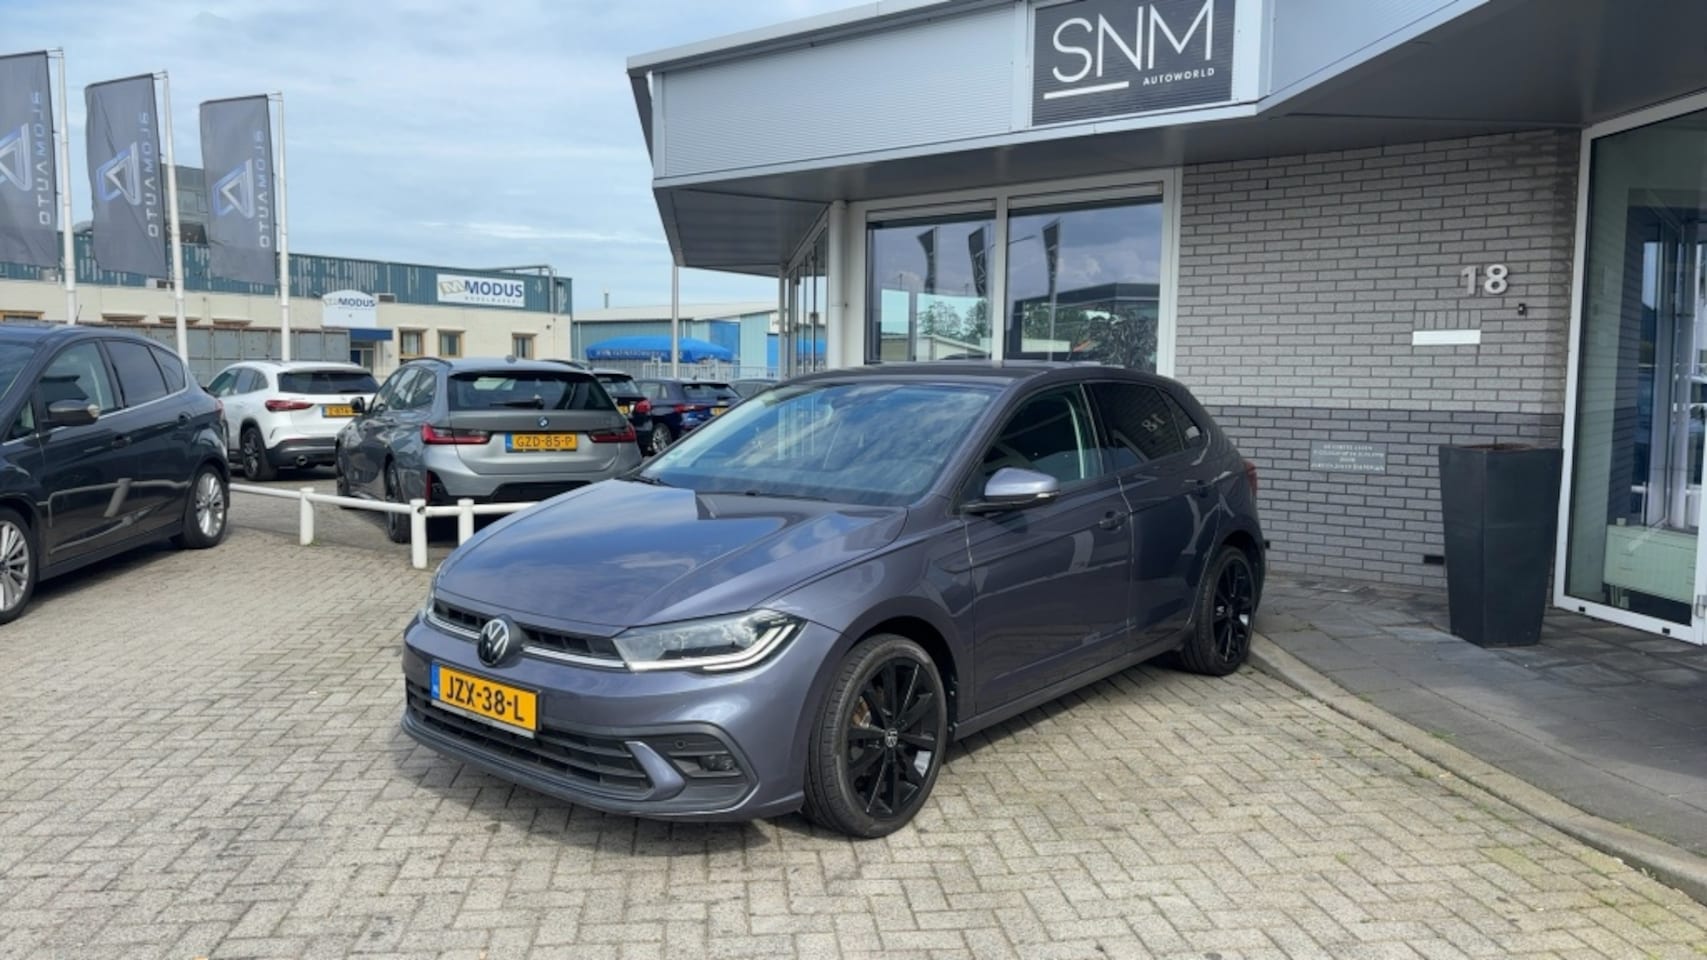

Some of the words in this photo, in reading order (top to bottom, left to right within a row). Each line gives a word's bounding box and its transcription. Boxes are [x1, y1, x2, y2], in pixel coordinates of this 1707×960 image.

[1052, 0, 1214, 83] SNM
[1142, 67, 1215, 86] AUTOWORLD
[464, 280, 523, 298] MODUS
[1461, 263, 1509, 296] 18
[338, 297, 376, 307] MODUS
[516, 435, 573, 448] GZD-85-P
[446, 676, 525, 722] JZX-38-L
